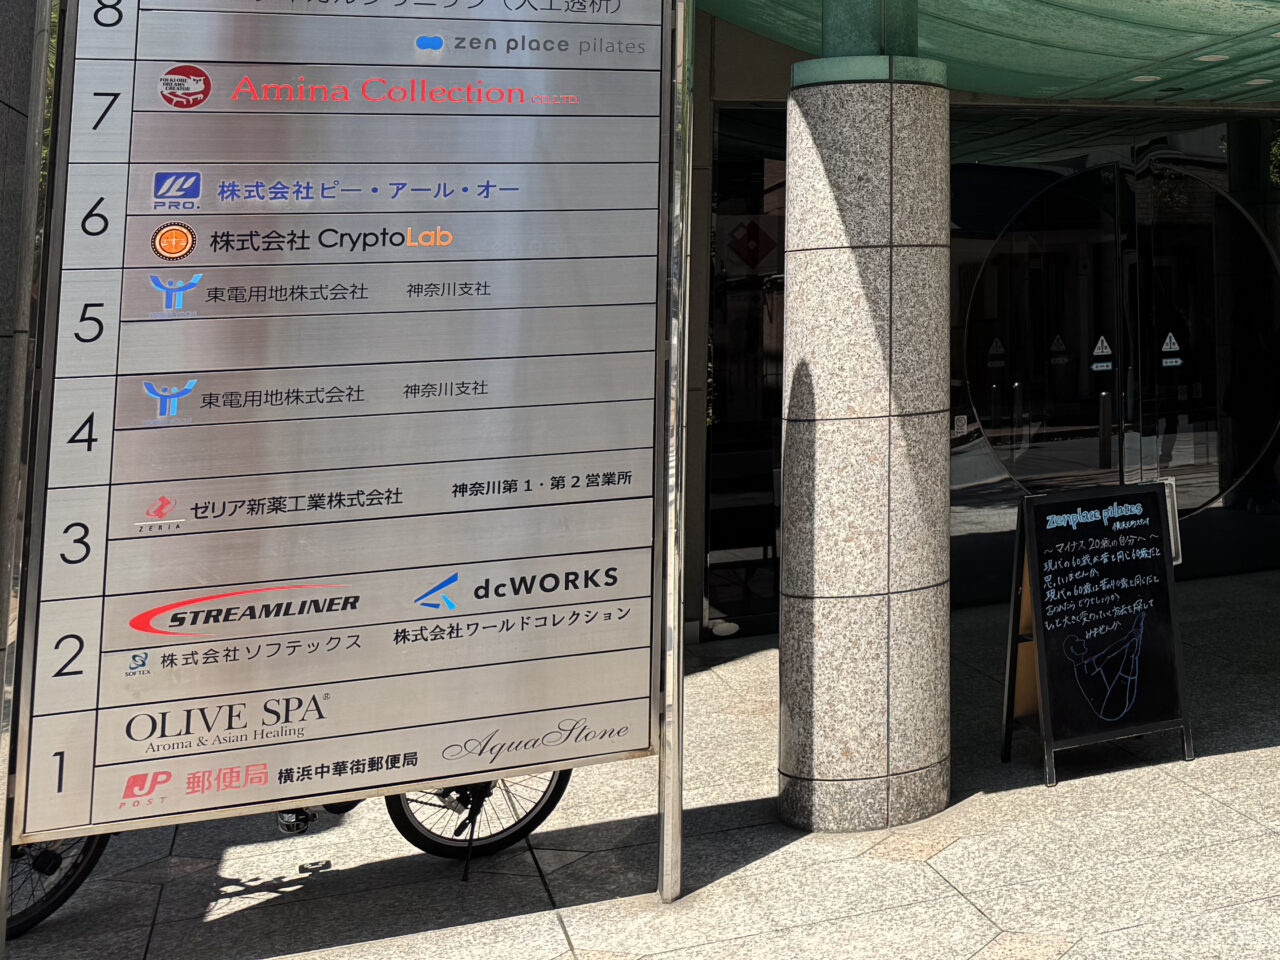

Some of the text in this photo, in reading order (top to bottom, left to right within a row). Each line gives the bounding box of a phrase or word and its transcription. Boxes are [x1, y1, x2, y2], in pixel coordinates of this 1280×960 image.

[454, 35, 646, 56] zen place pilates
[230, 76, 350, 102] Amina
[361, 78, 525, 104] Collection
[92, 92, 120, 131] 7
[218, 180, 520, 202] 株式会社ピー・アール・オー
[81, 196, 109, 236] 6
[210, 226, 453, 252] 株式会社 CryptoLab
[205, 281, 492, 303] 東電用地株式会社 神奈川支社
[74, 303, 104, 343] 5
[200, 380, 488, 409] 東電用地株式会社 神奈川支社
[66, 411, 98, 452] 4
[190, 488, 403, 520] ゼリア新薬工業株式会社
[59, 522, 92, 565] 3
[138, 524, 180, 533] ZERIA
[474, 567, 619, 600] dcWORKS
[168, 595, 360, 628] STREAMLINER
[392, 607, 631, 645] 株式会社ワールドコレクション
[52, 634, 85, 678] 2
[160, 634, 362, 669] 株式会社ソフテックス
[125, 702, 248, 742] OLIVE
[146, 726, 306, 754] Aroma & Asian Healing
[52, 750, 65, 794] 1
[186, 762, 268, 796] 郵便局
[278, 751, 418, 785] 横浜中華街郵便局
[119, 796, 166, 808] POST
